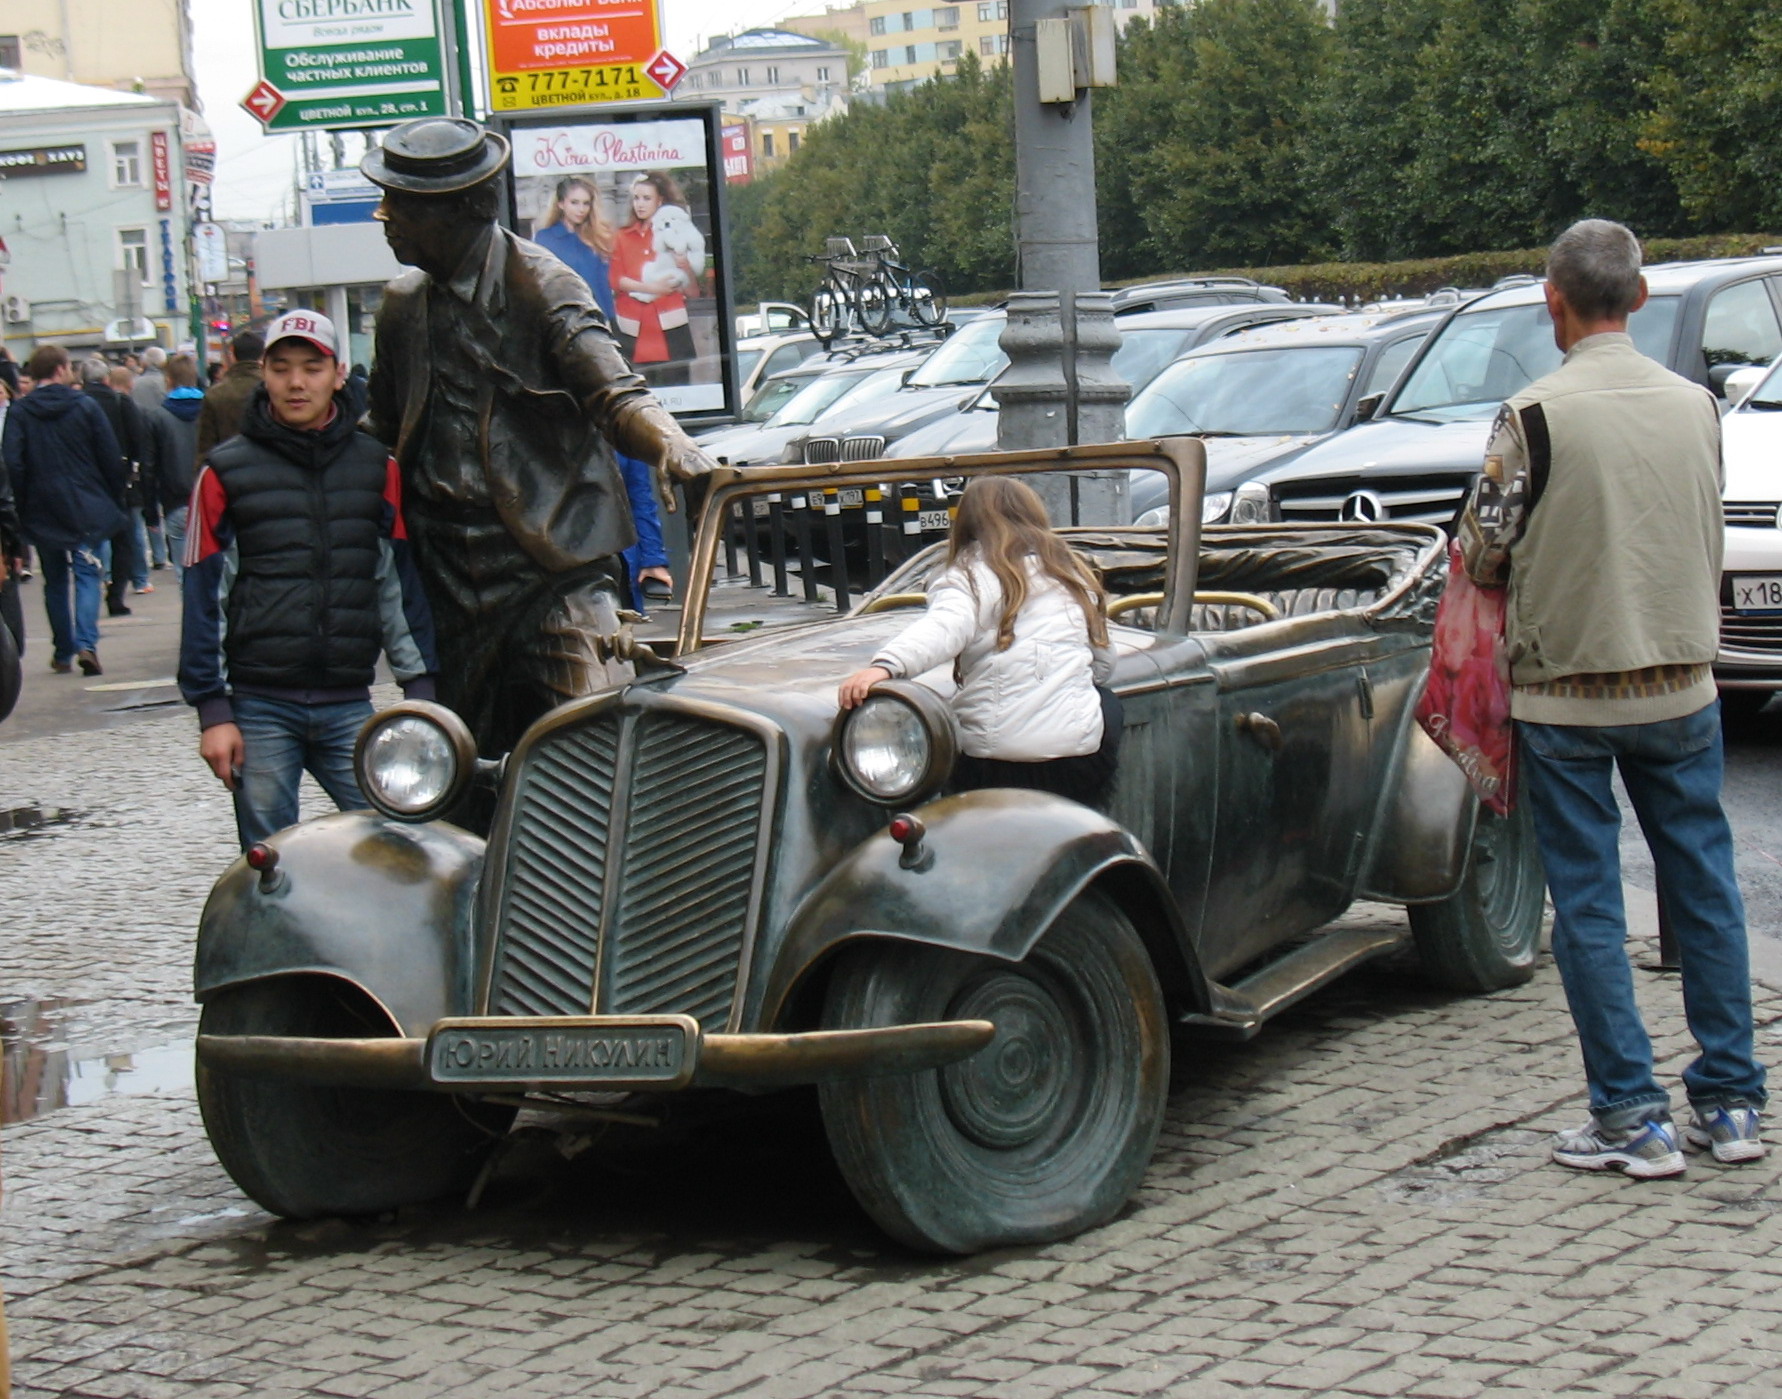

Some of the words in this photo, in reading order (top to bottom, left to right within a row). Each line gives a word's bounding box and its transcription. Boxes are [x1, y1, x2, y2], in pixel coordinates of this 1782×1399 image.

[536, 25, 609, 41] вклады
[285, 49, 404, 67] Обслуживание
[534, 40, 615, 59] кредиты
[286, 67, 352, 82] частных
[355, 62, 428, 78] клиентов
[528, 66, 639, 91] 777-7171
[532, 90, 586, 106] ЦВЕТНОЙ
[627, 87, 640, 97] 18
[300, 104, 352, 122] ЦВЕТНОЙ
[534, 133, 592, 168] Kira
[594, 131, 685, 165] Plastinina
[280, 317, 317, 333] FBI
[445, 1036, 534, 1069] ЮРИЙ
[543, 1035, 674, 1069] НИКУЛИН
